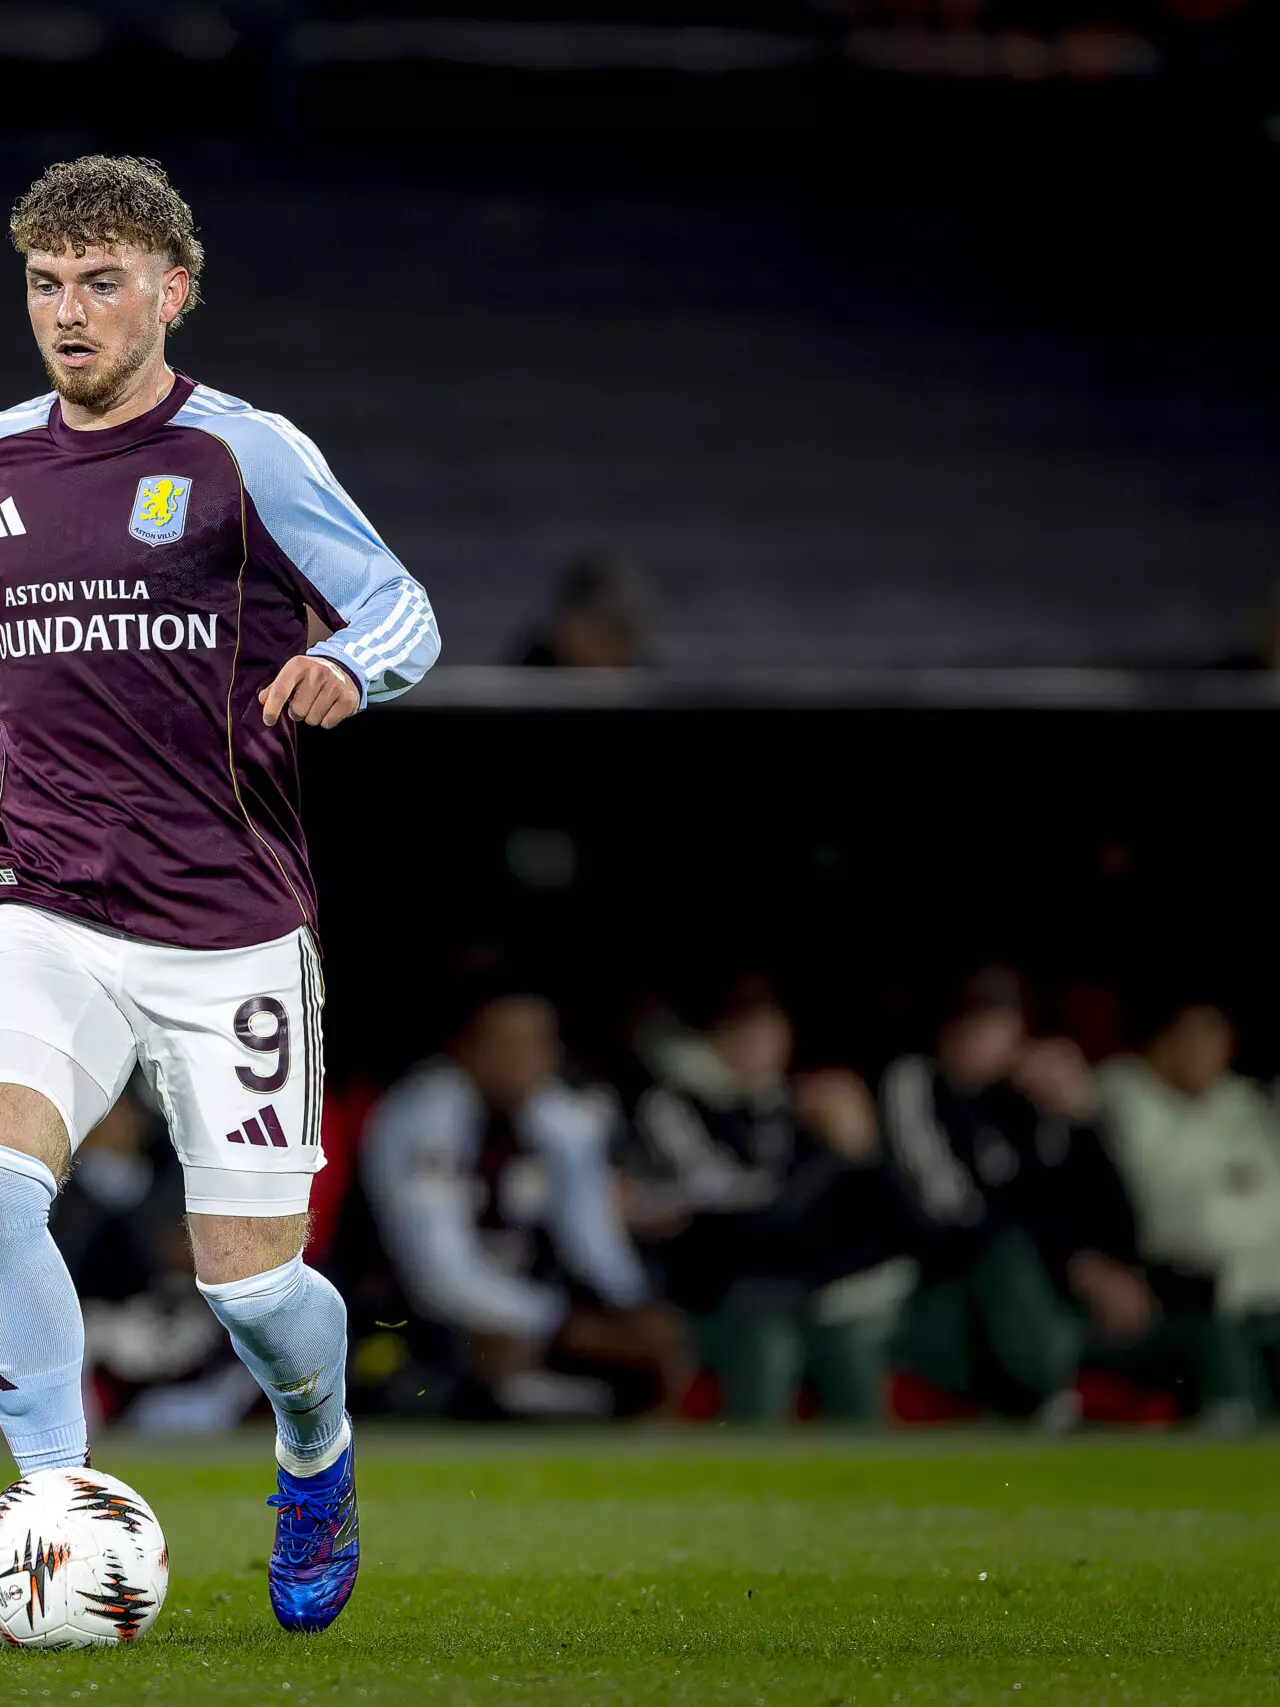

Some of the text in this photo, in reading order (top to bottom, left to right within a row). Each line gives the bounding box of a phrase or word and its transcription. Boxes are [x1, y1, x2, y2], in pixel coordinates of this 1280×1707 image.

[133, 527, 178, 539] ASTON VILLA
[5, 579, 150, 607] ASTON VILLA
[233, 996, 291, 1094] 9
